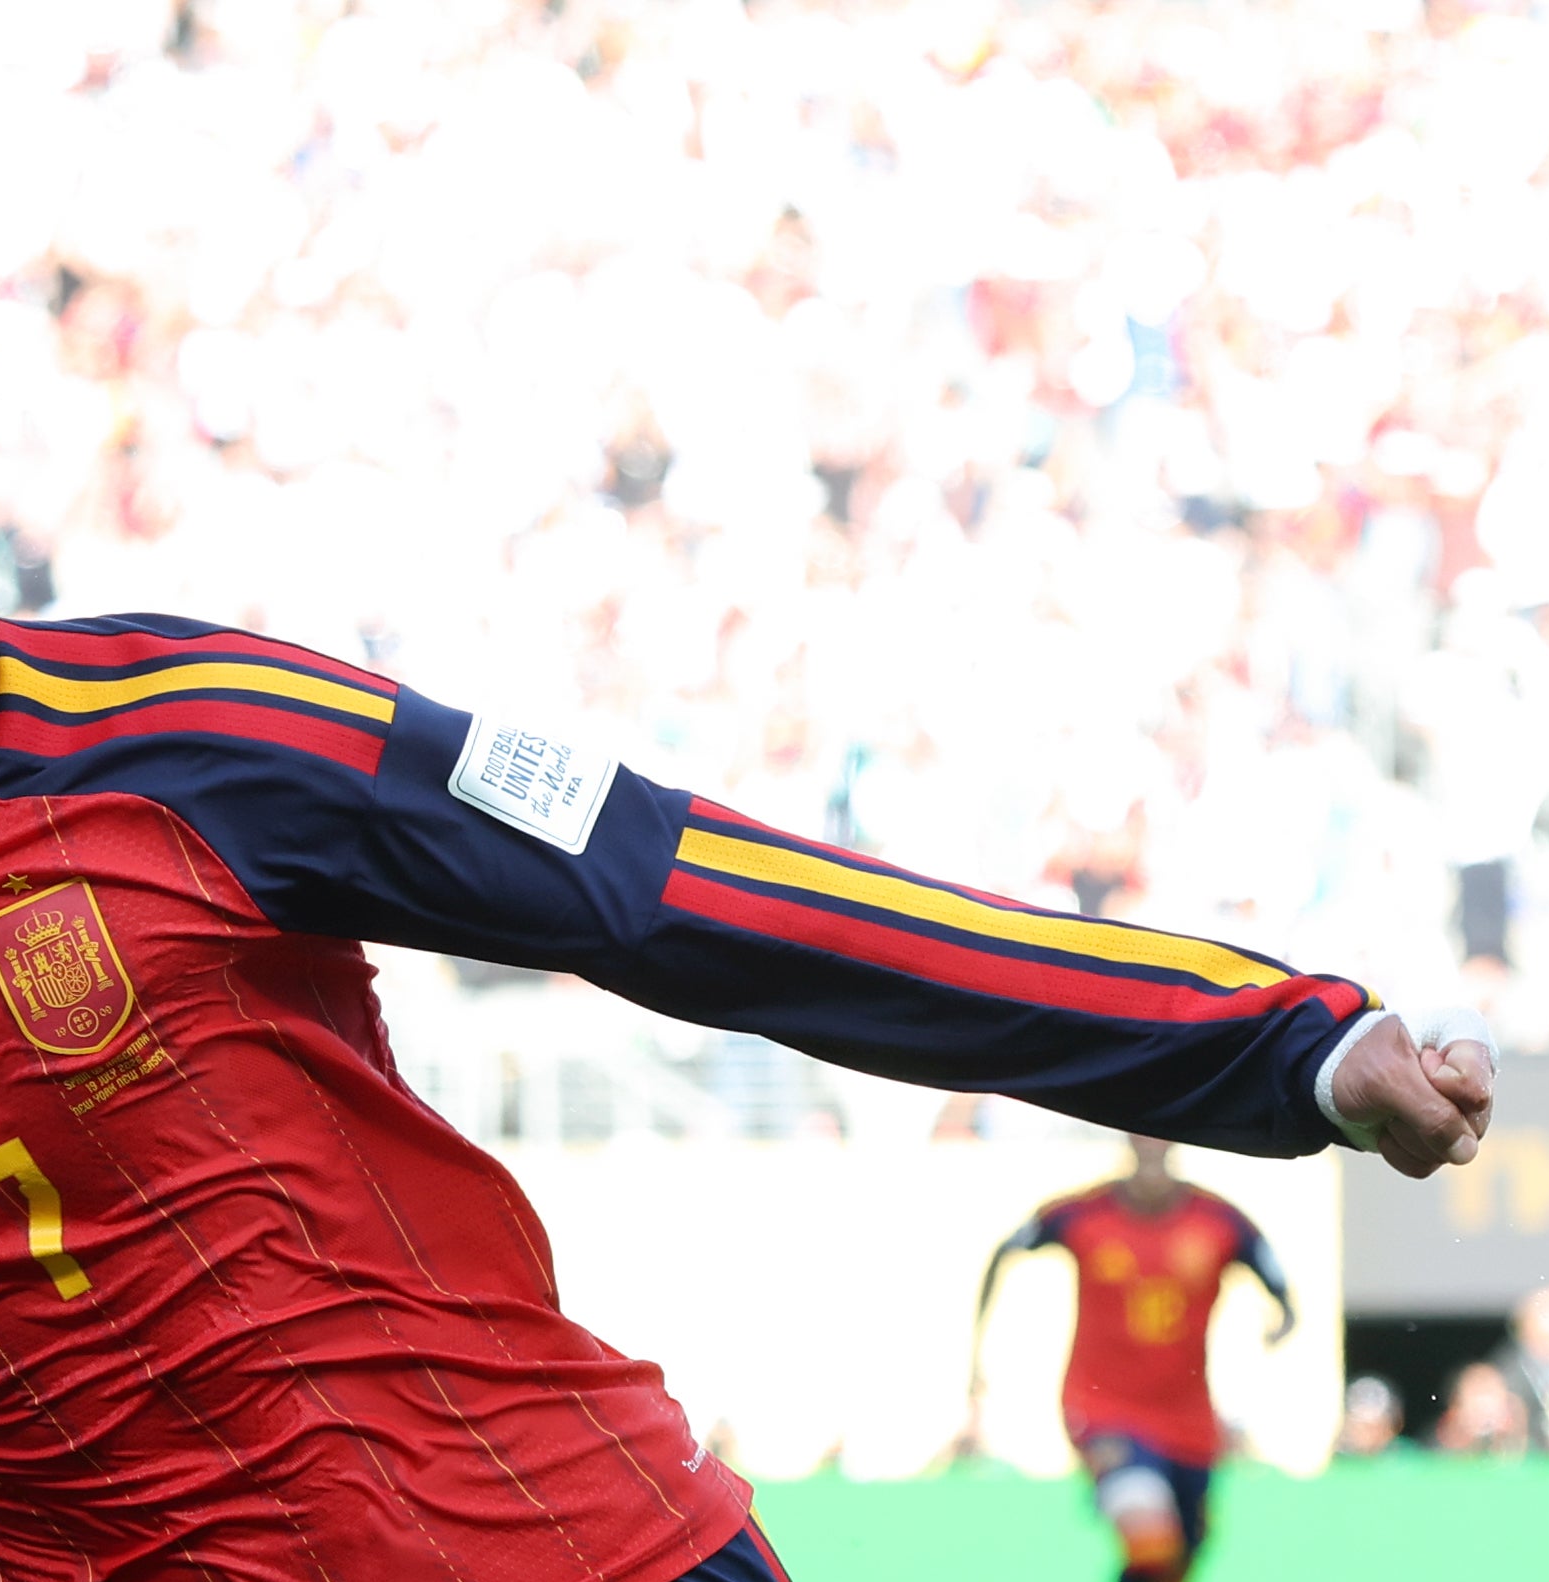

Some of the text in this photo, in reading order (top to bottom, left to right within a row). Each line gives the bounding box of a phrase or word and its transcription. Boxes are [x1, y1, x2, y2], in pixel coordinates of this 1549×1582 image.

[501, 732, 547, 800] UNITES
[531, 792, 553, 818] the
[562, 776, 582, 806] FIFA
[85, 1081, 98, 1094] 19
[98, 1068, 118, 1087] JULY
